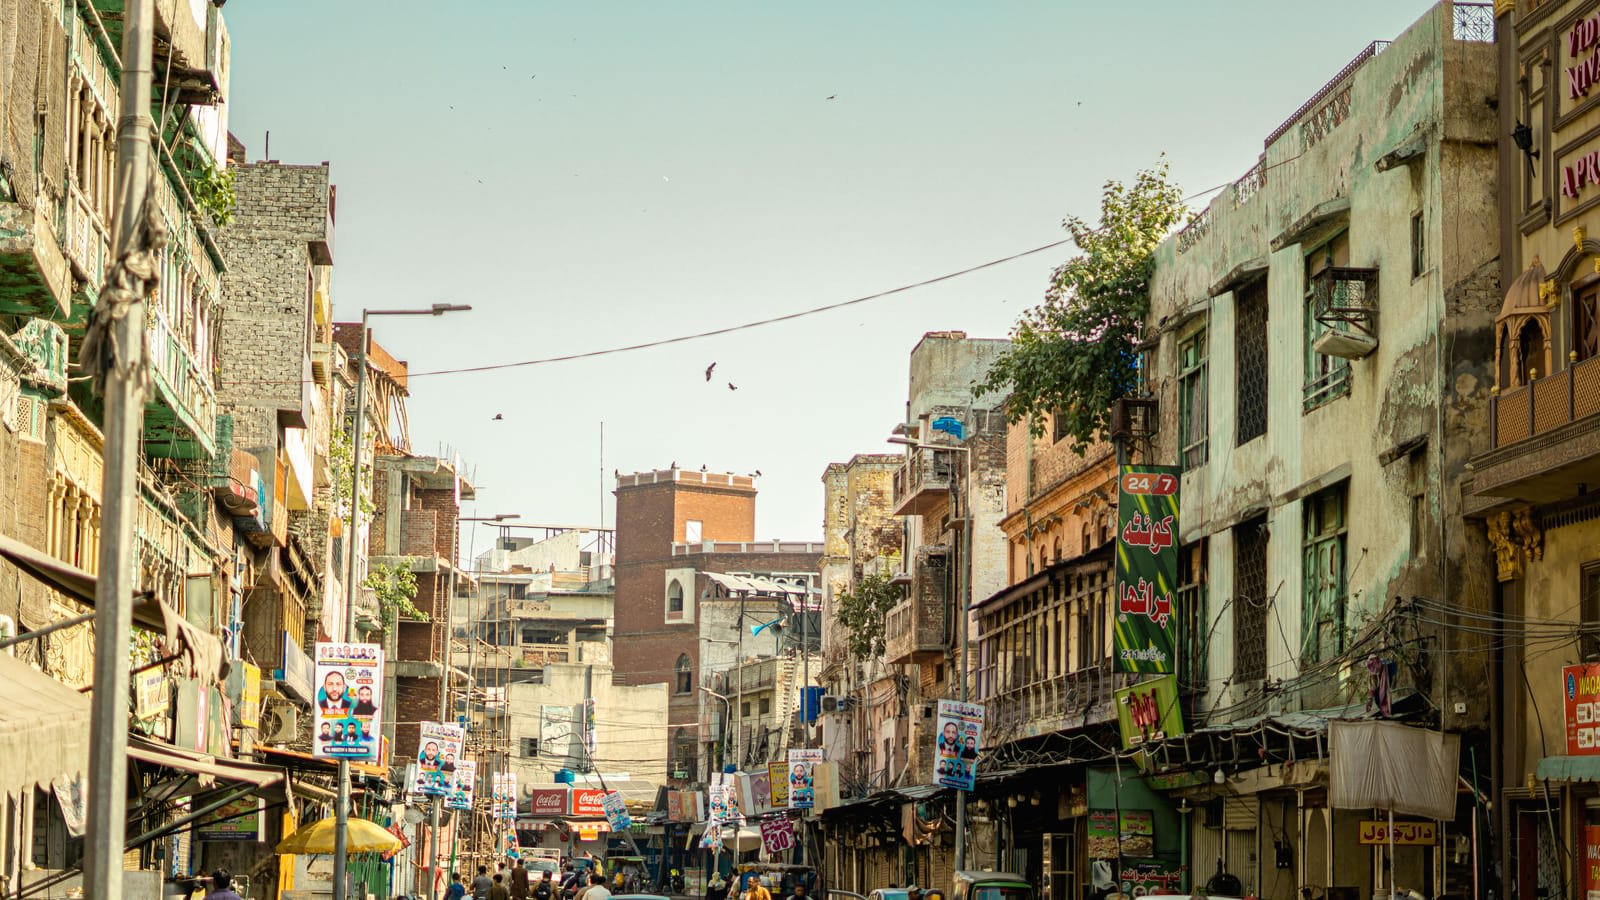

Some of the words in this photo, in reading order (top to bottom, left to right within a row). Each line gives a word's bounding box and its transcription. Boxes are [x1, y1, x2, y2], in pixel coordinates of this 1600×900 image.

[1562, 166, 1576, 198] A
[1128, 477, 1149, 490] 24
[1162, 478, 1173, 491] 7
[1121, 511, 1174, 554] کوئٹہ
[1119, 577, 1172, 629] پراٹھا
[770, 830, 789, 851] 30
